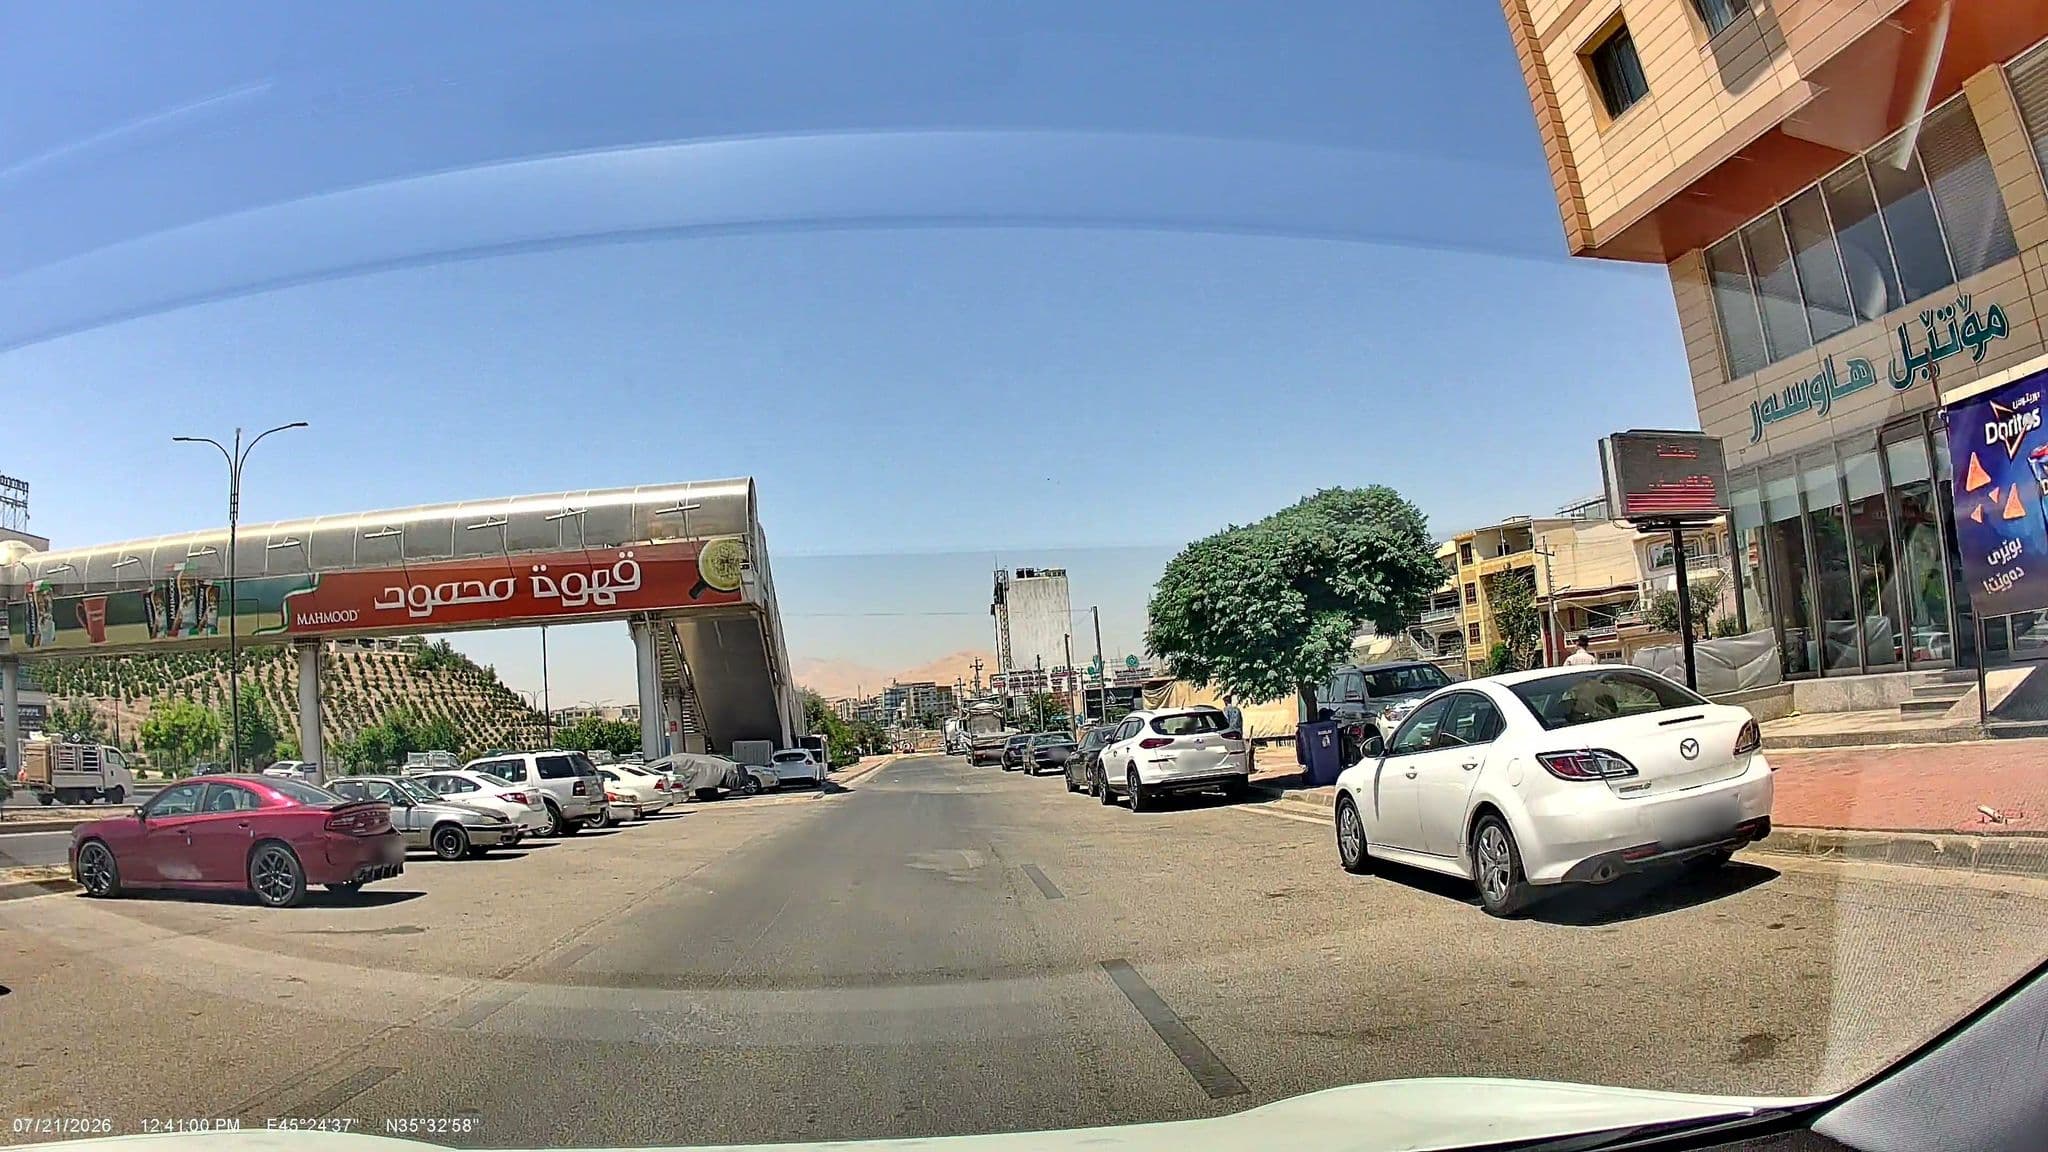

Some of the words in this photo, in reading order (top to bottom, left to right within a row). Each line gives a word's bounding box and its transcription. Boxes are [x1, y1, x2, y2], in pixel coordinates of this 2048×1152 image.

[1749, 353, 1877, 446] هاوسەر
[1985, 406, 2041, 445] Doritos
[374, 577, 517, 618] محمود
[529, 551, 642, 607] قهوة
[296, 609, 359, 626] MAHMOOD
